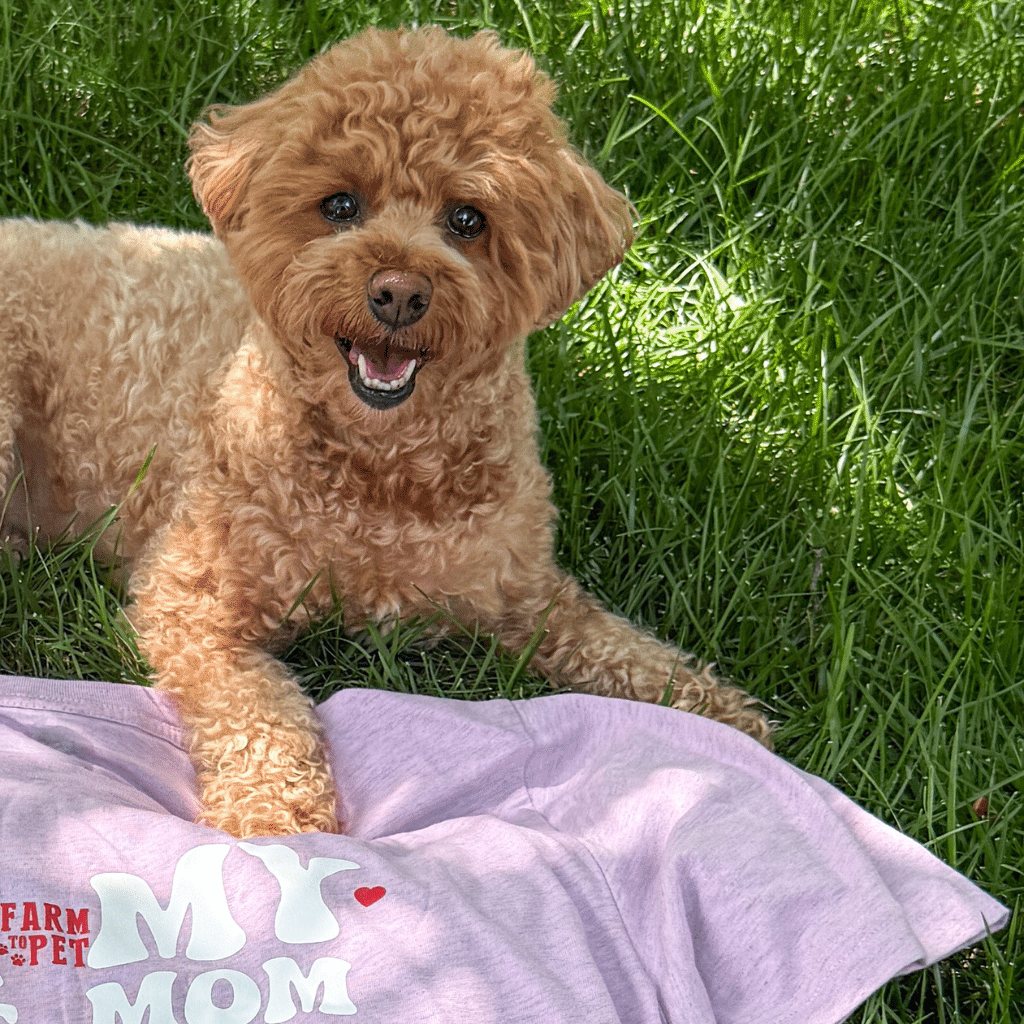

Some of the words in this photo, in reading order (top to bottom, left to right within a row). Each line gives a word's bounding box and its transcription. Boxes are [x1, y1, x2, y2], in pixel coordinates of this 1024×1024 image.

[0, 901, 90, 935] FARM
[87, 841, 361, 969] MY
[7, 935, 27, 949] TO
[28, 934, 89, 968] PET
